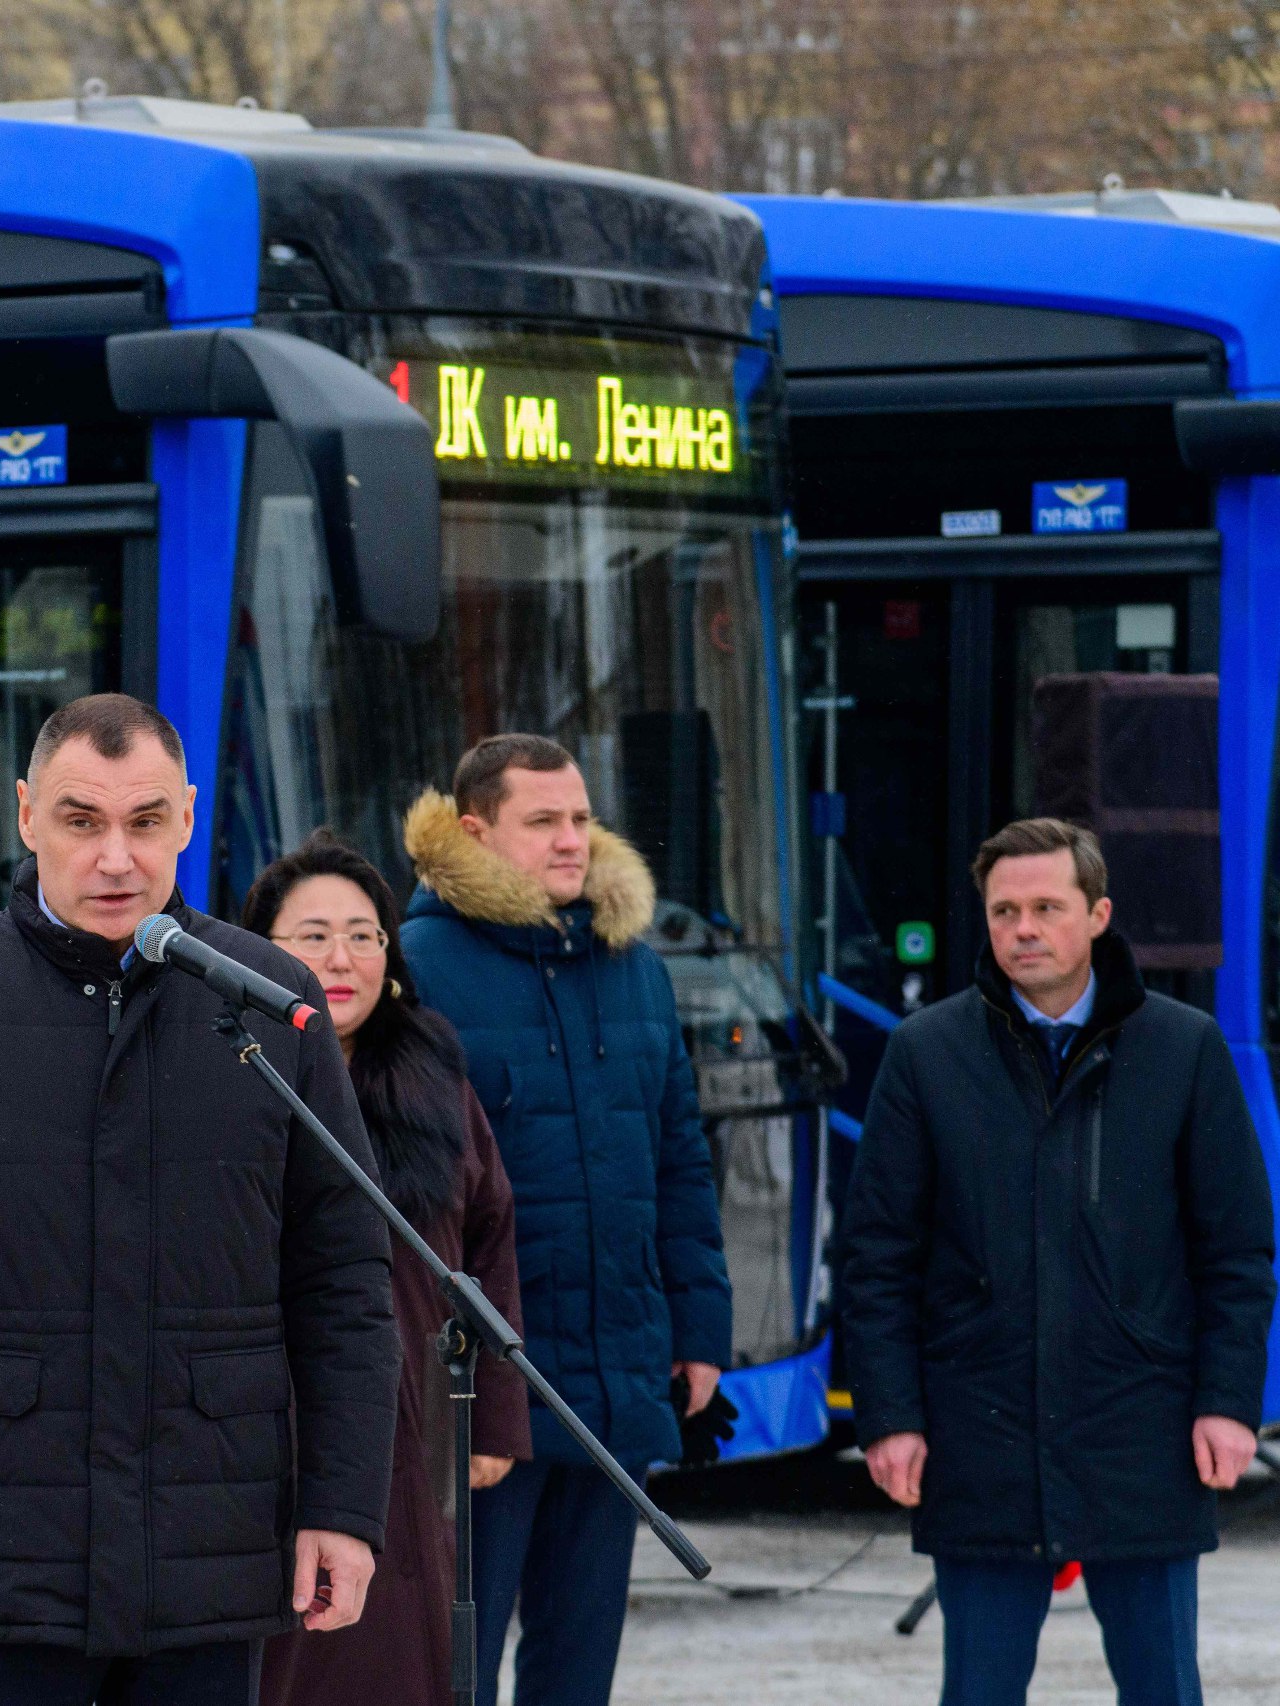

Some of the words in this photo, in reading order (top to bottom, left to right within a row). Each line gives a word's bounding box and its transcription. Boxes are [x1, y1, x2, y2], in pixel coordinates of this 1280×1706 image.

[435, 364, 488, 459] ДК
[506, 395, 572, 461] им.
[596, 376, 733, 472] Ленина
